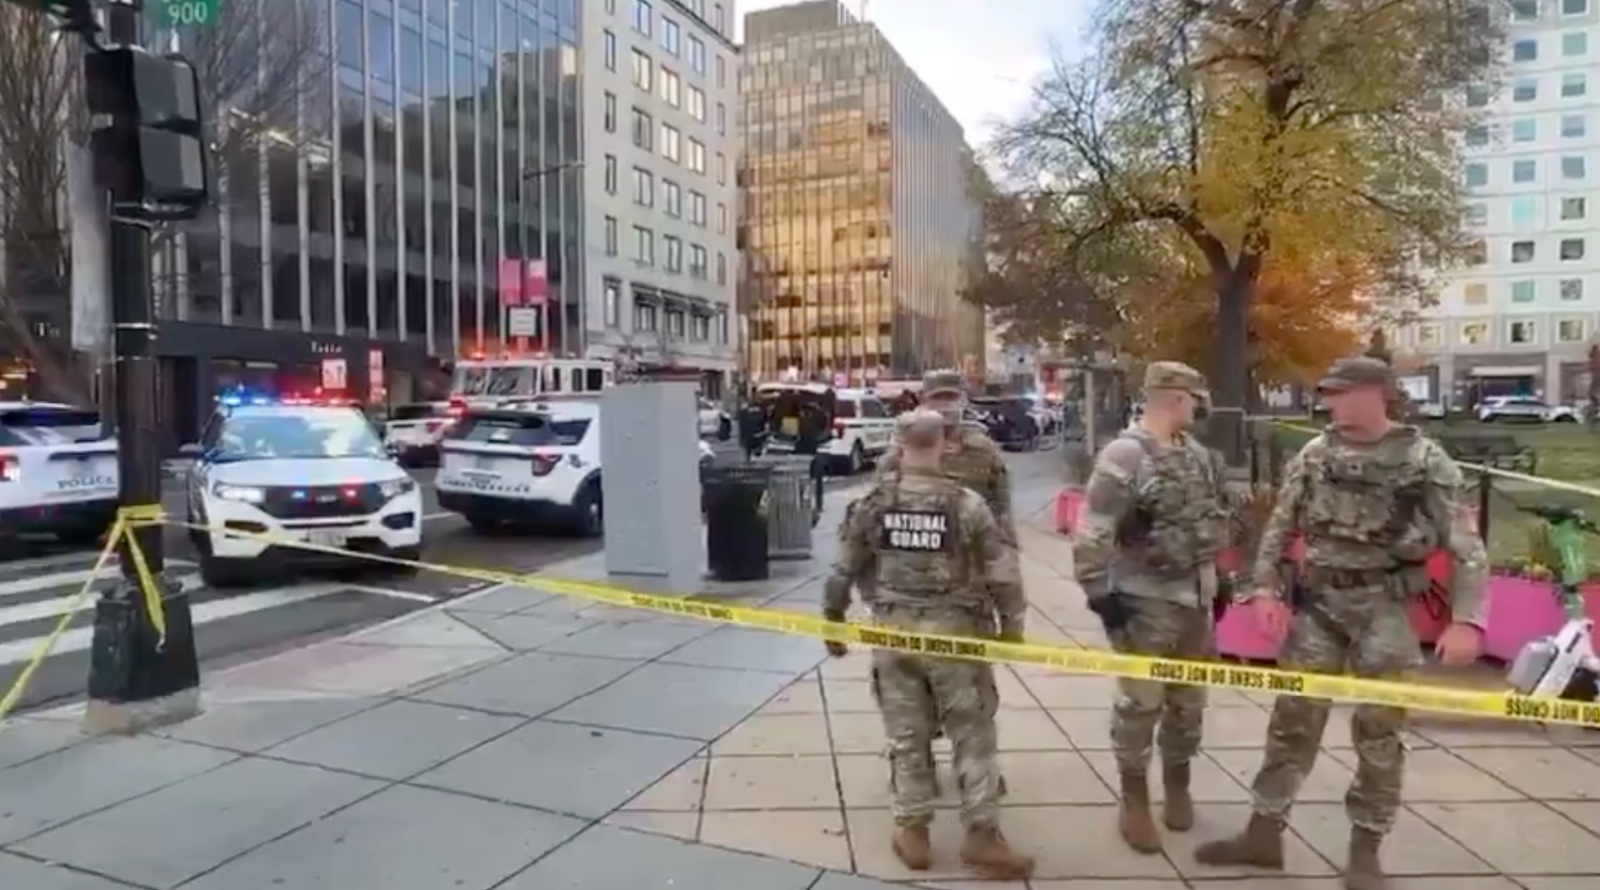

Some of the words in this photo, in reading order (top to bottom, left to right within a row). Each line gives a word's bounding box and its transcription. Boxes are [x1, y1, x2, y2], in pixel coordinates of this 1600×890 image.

[168, 2, 208, 25] 900
[58, 476, 116, 489] POLICE
[884, 513, 947, 532] NATIONAL
[890, 530, 941, 549] GUARD
[1186, 665, 1207, 682] NOT
[1211, 668, 1226, 686] DO
[1229, 669, 1264, 689] SCENE
[1267, 673, 1304, 693] CRIME
[1505, 698, 1549, 718] CROSS
[1552, 703, 1579, 722] NOT
